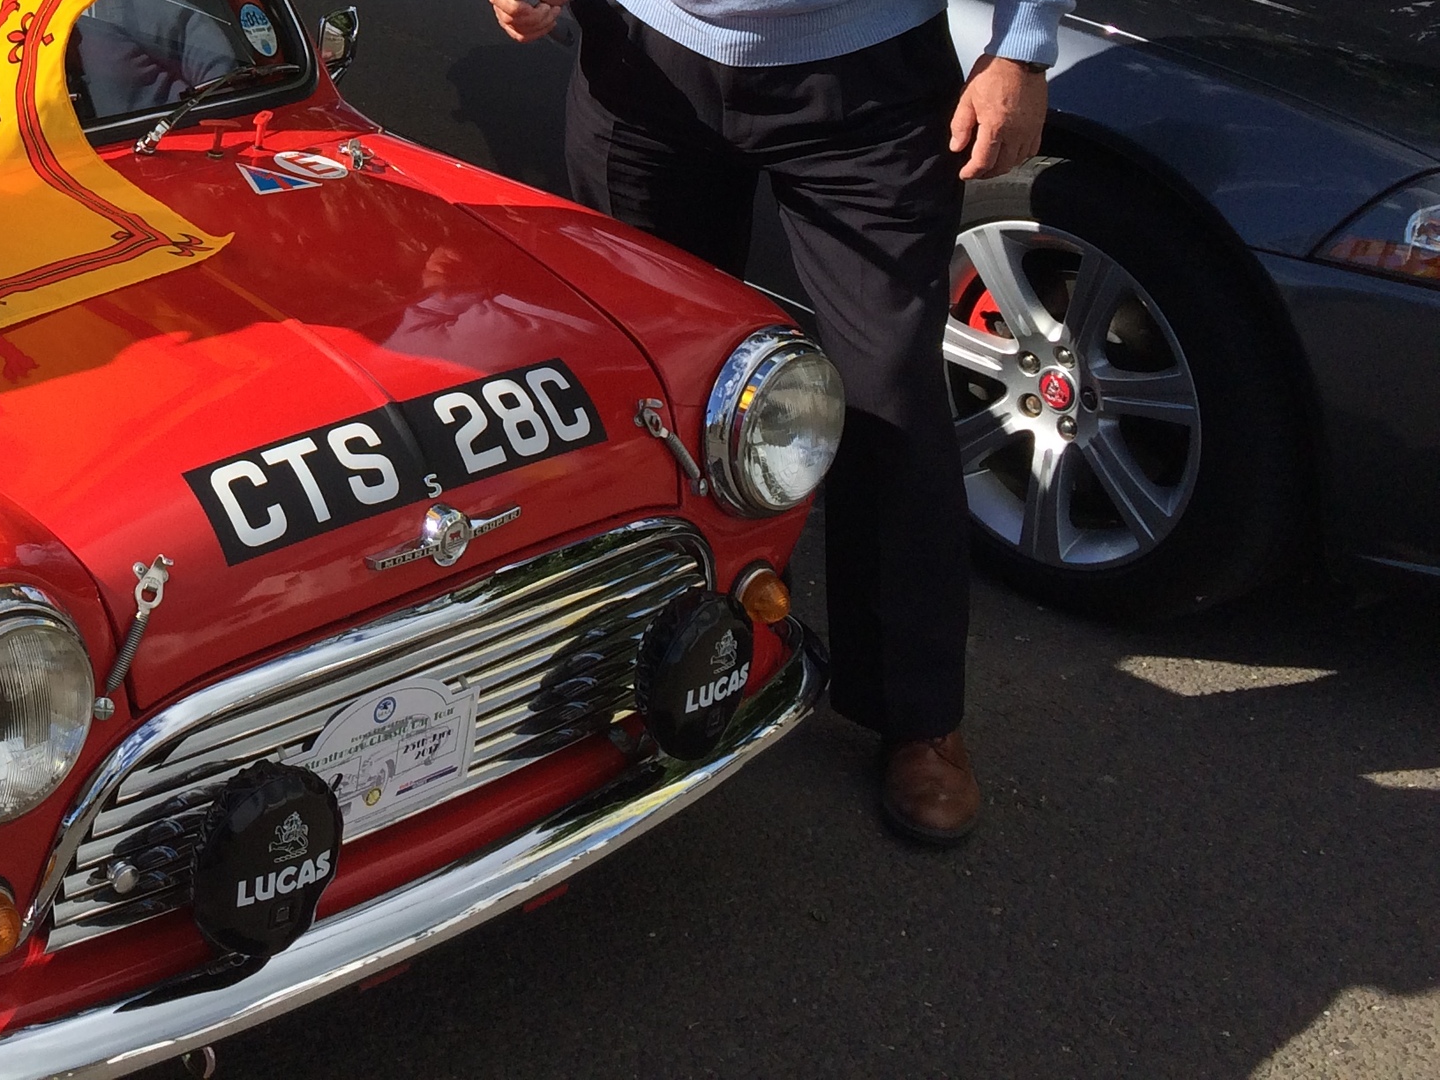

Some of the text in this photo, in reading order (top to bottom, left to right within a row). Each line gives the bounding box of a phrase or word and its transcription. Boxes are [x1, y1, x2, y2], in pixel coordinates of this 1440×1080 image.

[210, 366, 591, 548] CTS 28C
[423, 473, 442, 499] S
[383, 508, 521, 569] MORRIS COOPER
[684, 661, 750, 714] LUCAS
[236, 848, 332, 908] LUCAS
